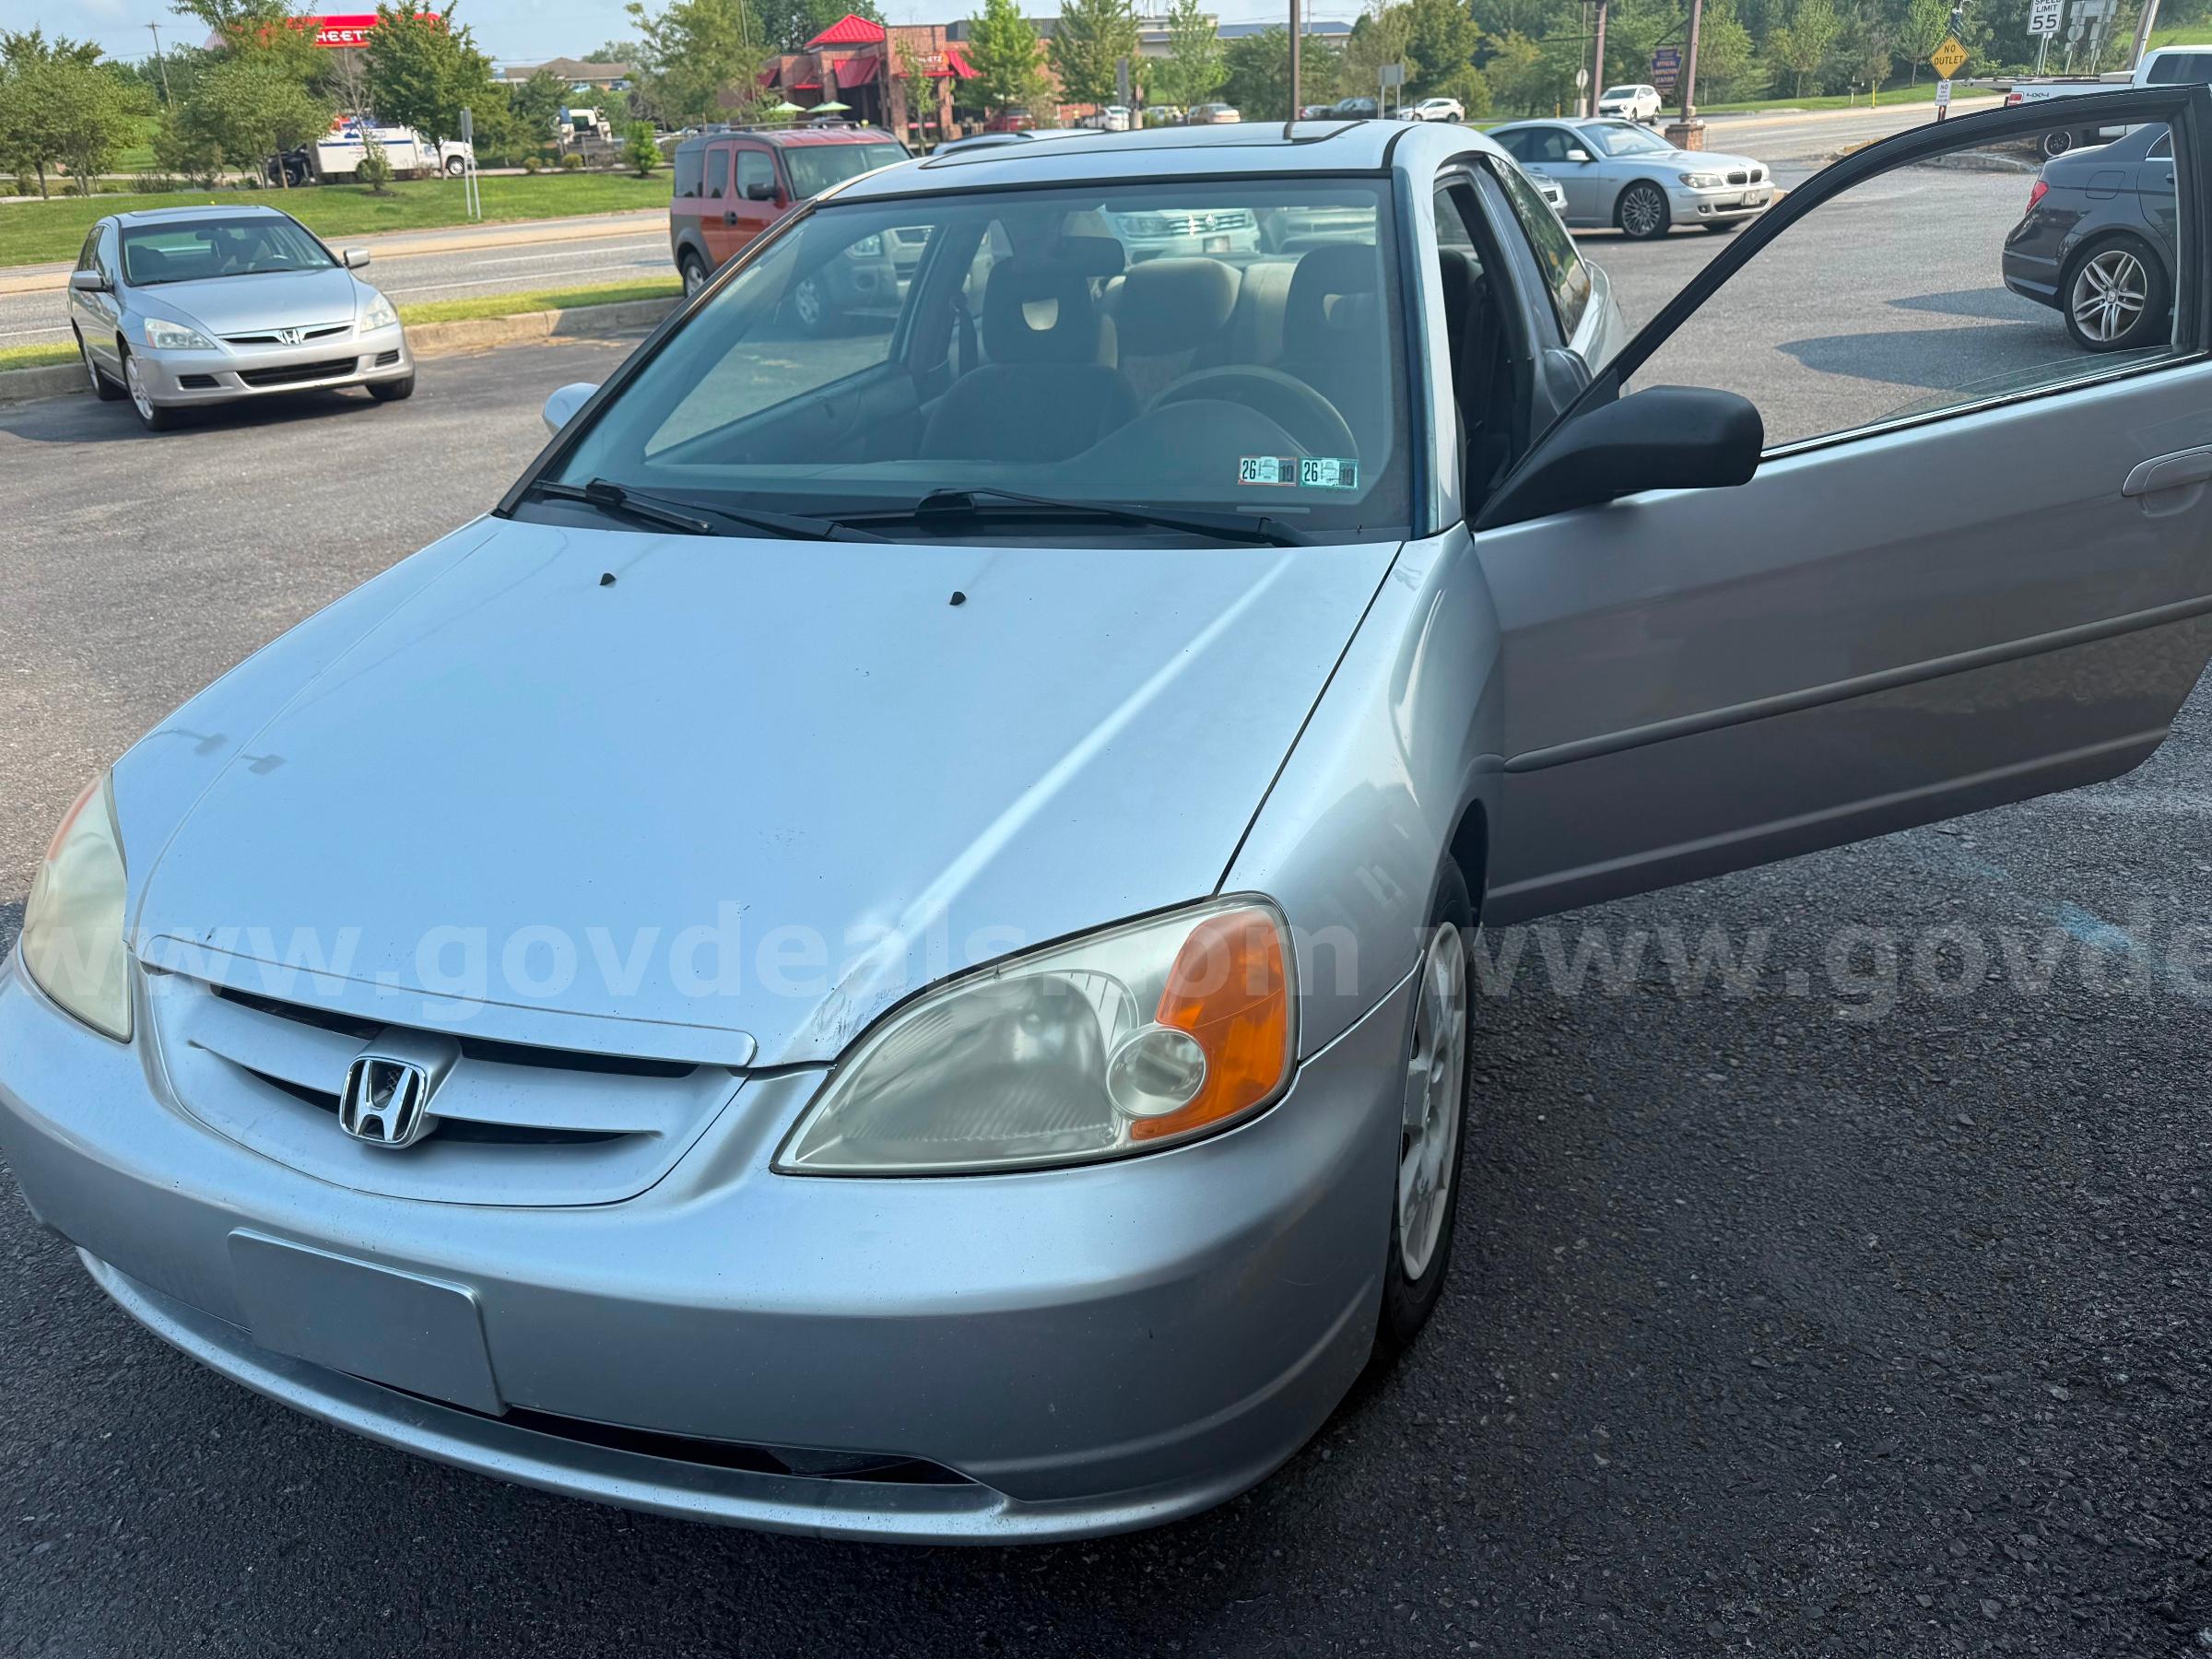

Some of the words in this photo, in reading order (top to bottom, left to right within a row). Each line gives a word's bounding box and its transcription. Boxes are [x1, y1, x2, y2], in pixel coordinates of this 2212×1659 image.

[2036, 5, 2057, 13] LIMIT
[2032, 14, 2057, 30] 55
[1944, 44, 1956, 53] NO
[1934, 55, 1964, 66] OUTLET
[1241, 460, 1256, 479] 26
[1304, 462, 1318, 482] 26
